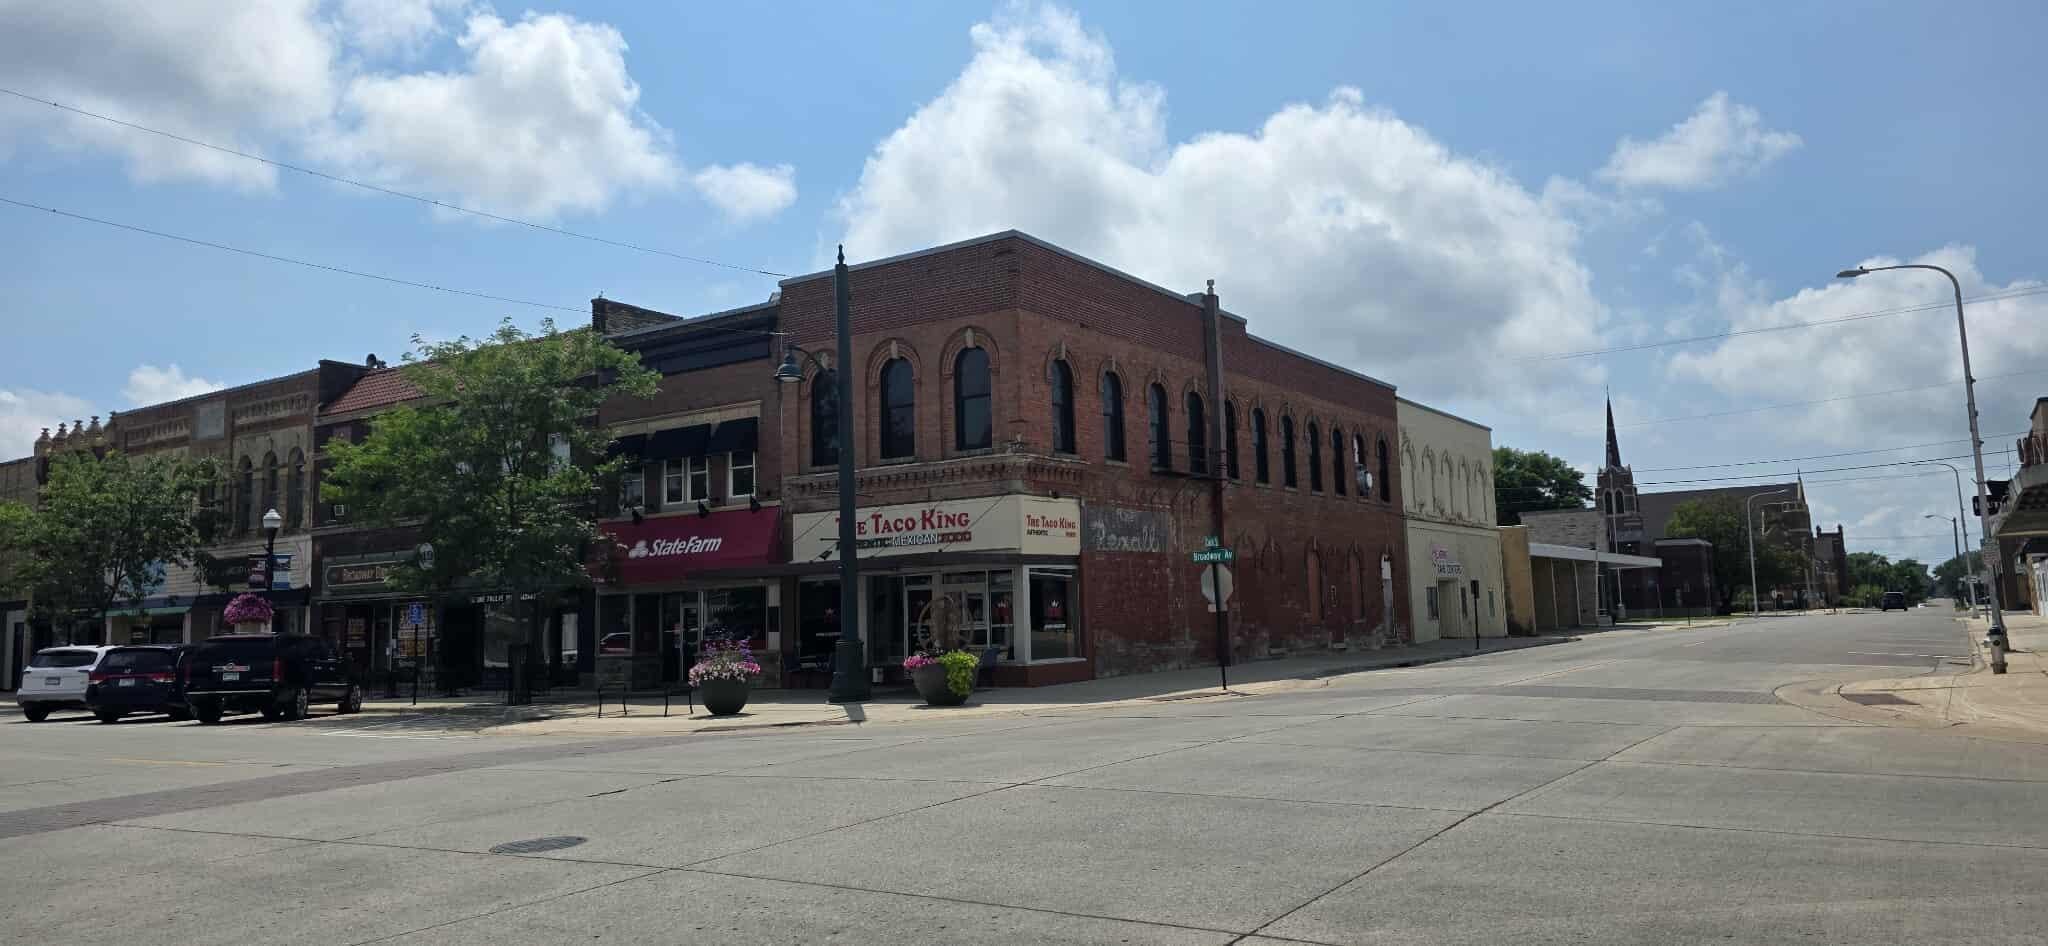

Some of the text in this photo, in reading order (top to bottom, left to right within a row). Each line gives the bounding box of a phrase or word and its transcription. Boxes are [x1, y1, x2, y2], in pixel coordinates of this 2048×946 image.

[871, 512, 916, 534] TACO
[1041, 516, 1058, 529] TACO
[892, 533, 938, 546] MEXICAN
[1193, 551, 1221, 562] Broadway
